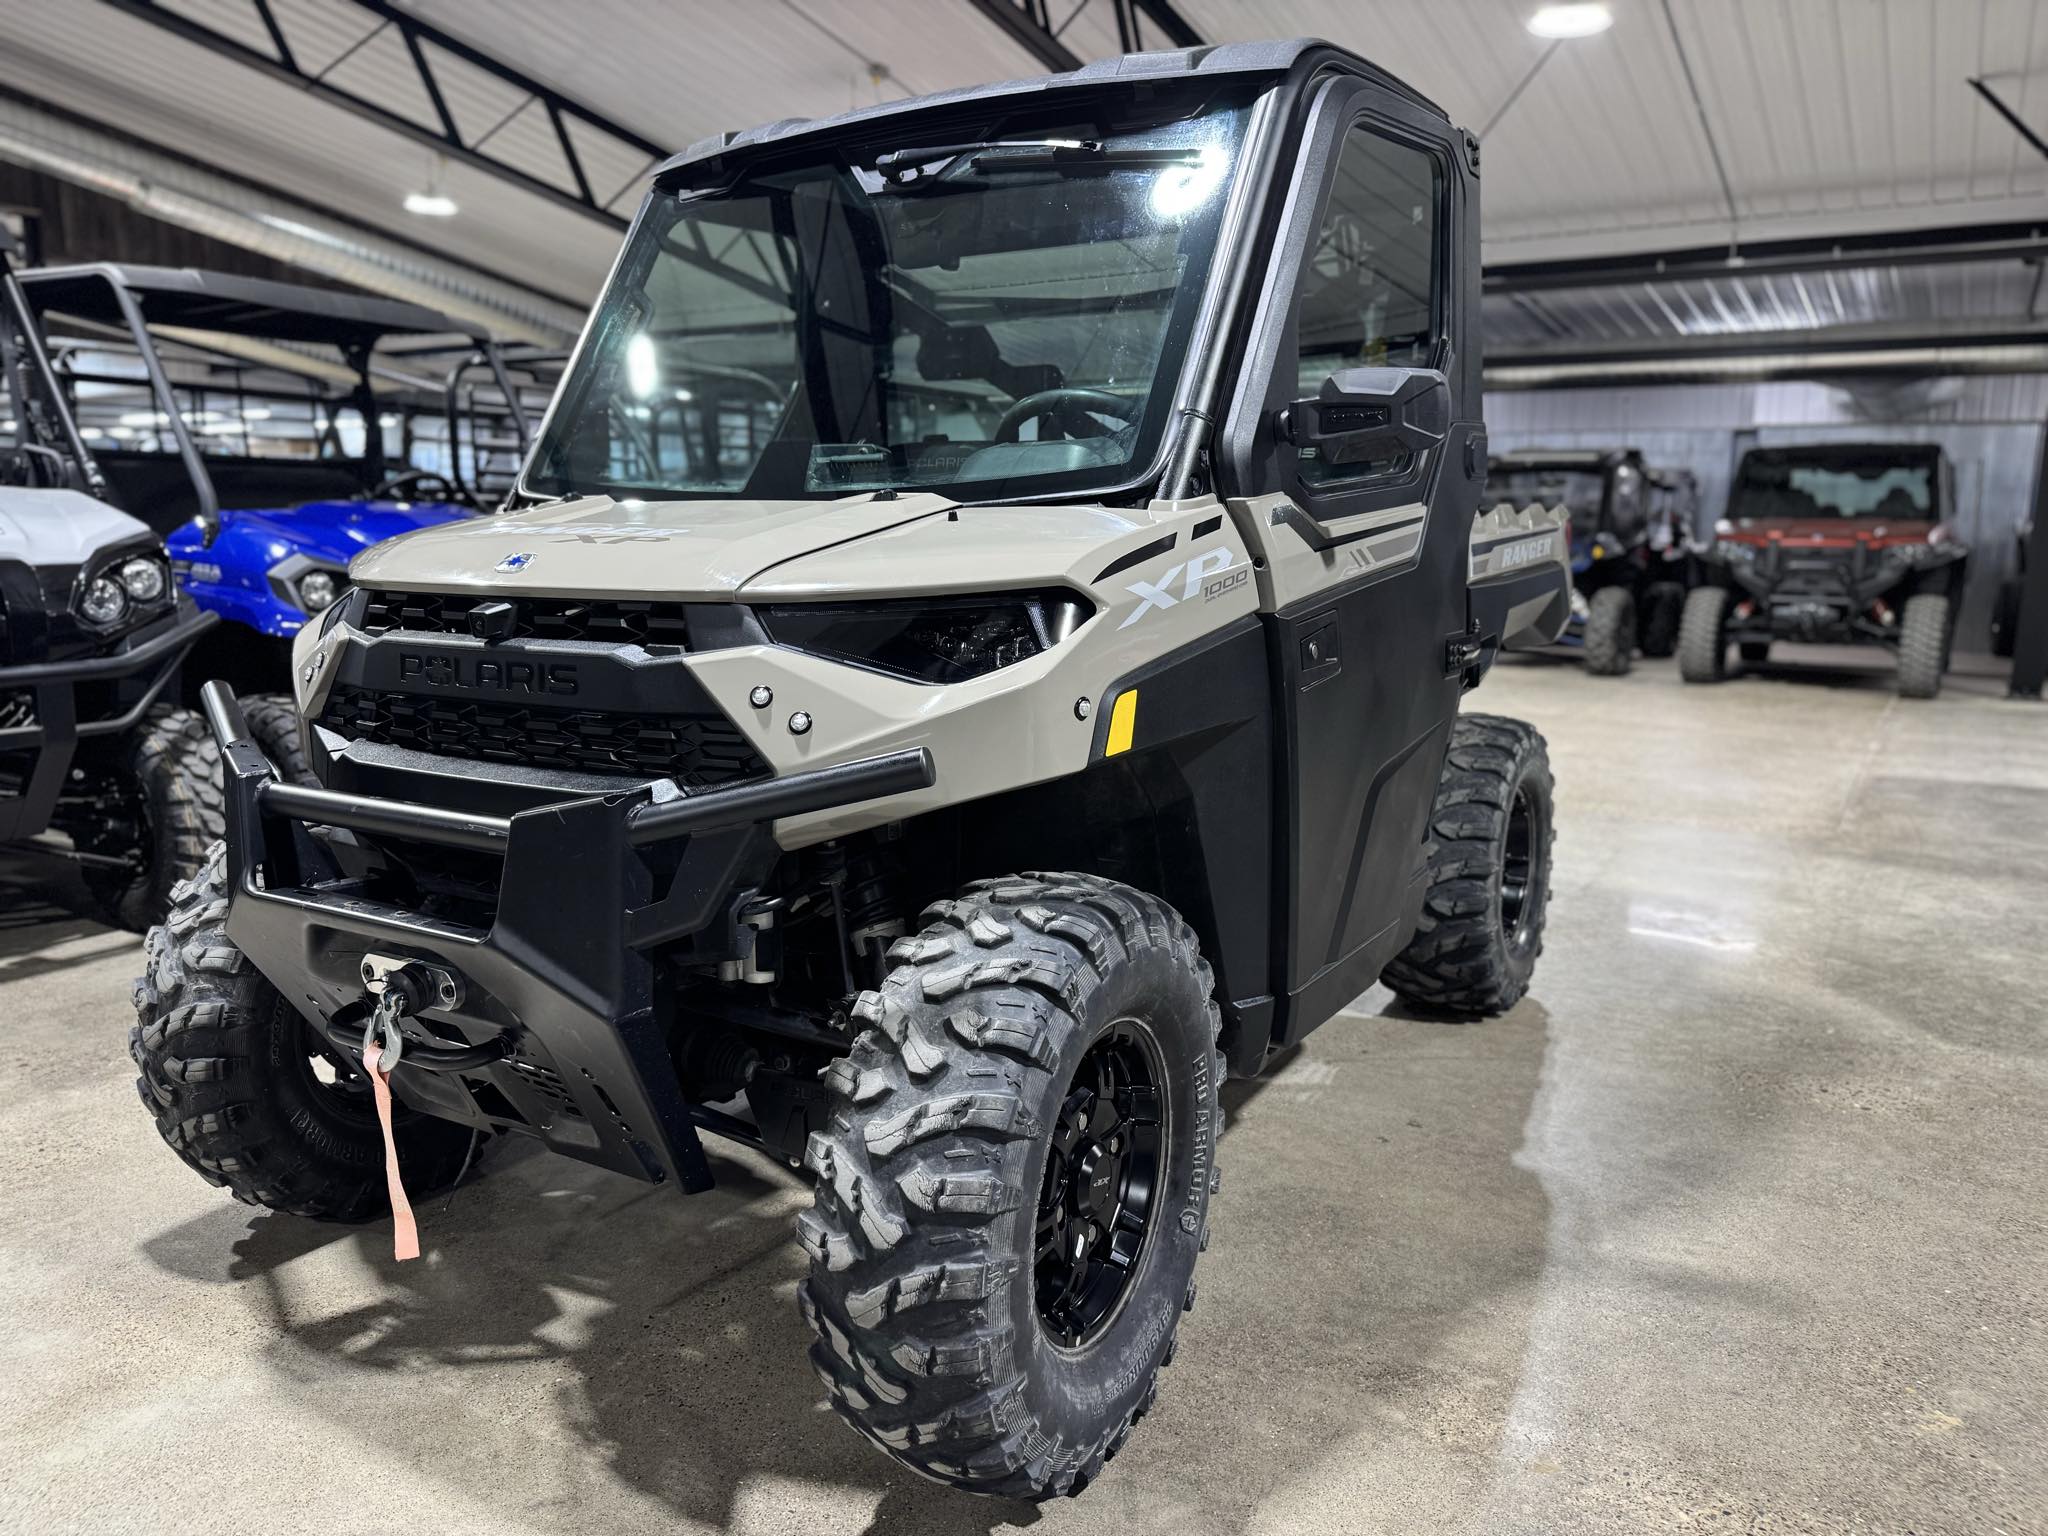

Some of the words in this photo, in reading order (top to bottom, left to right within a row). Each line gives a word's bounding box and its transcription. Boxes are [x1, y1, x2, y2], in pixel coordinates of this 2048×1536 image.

[1502, 537, 1552, 569] RANGER
[1116, 546, 1234, 632] XP
[1203, 569, 1248, 598] 1000
[400, 652, 579, 696] POLARIS
[1193, 1052, 1210, 1104] PRO
[1187, 1110, 1210, 1208] ARMOR
